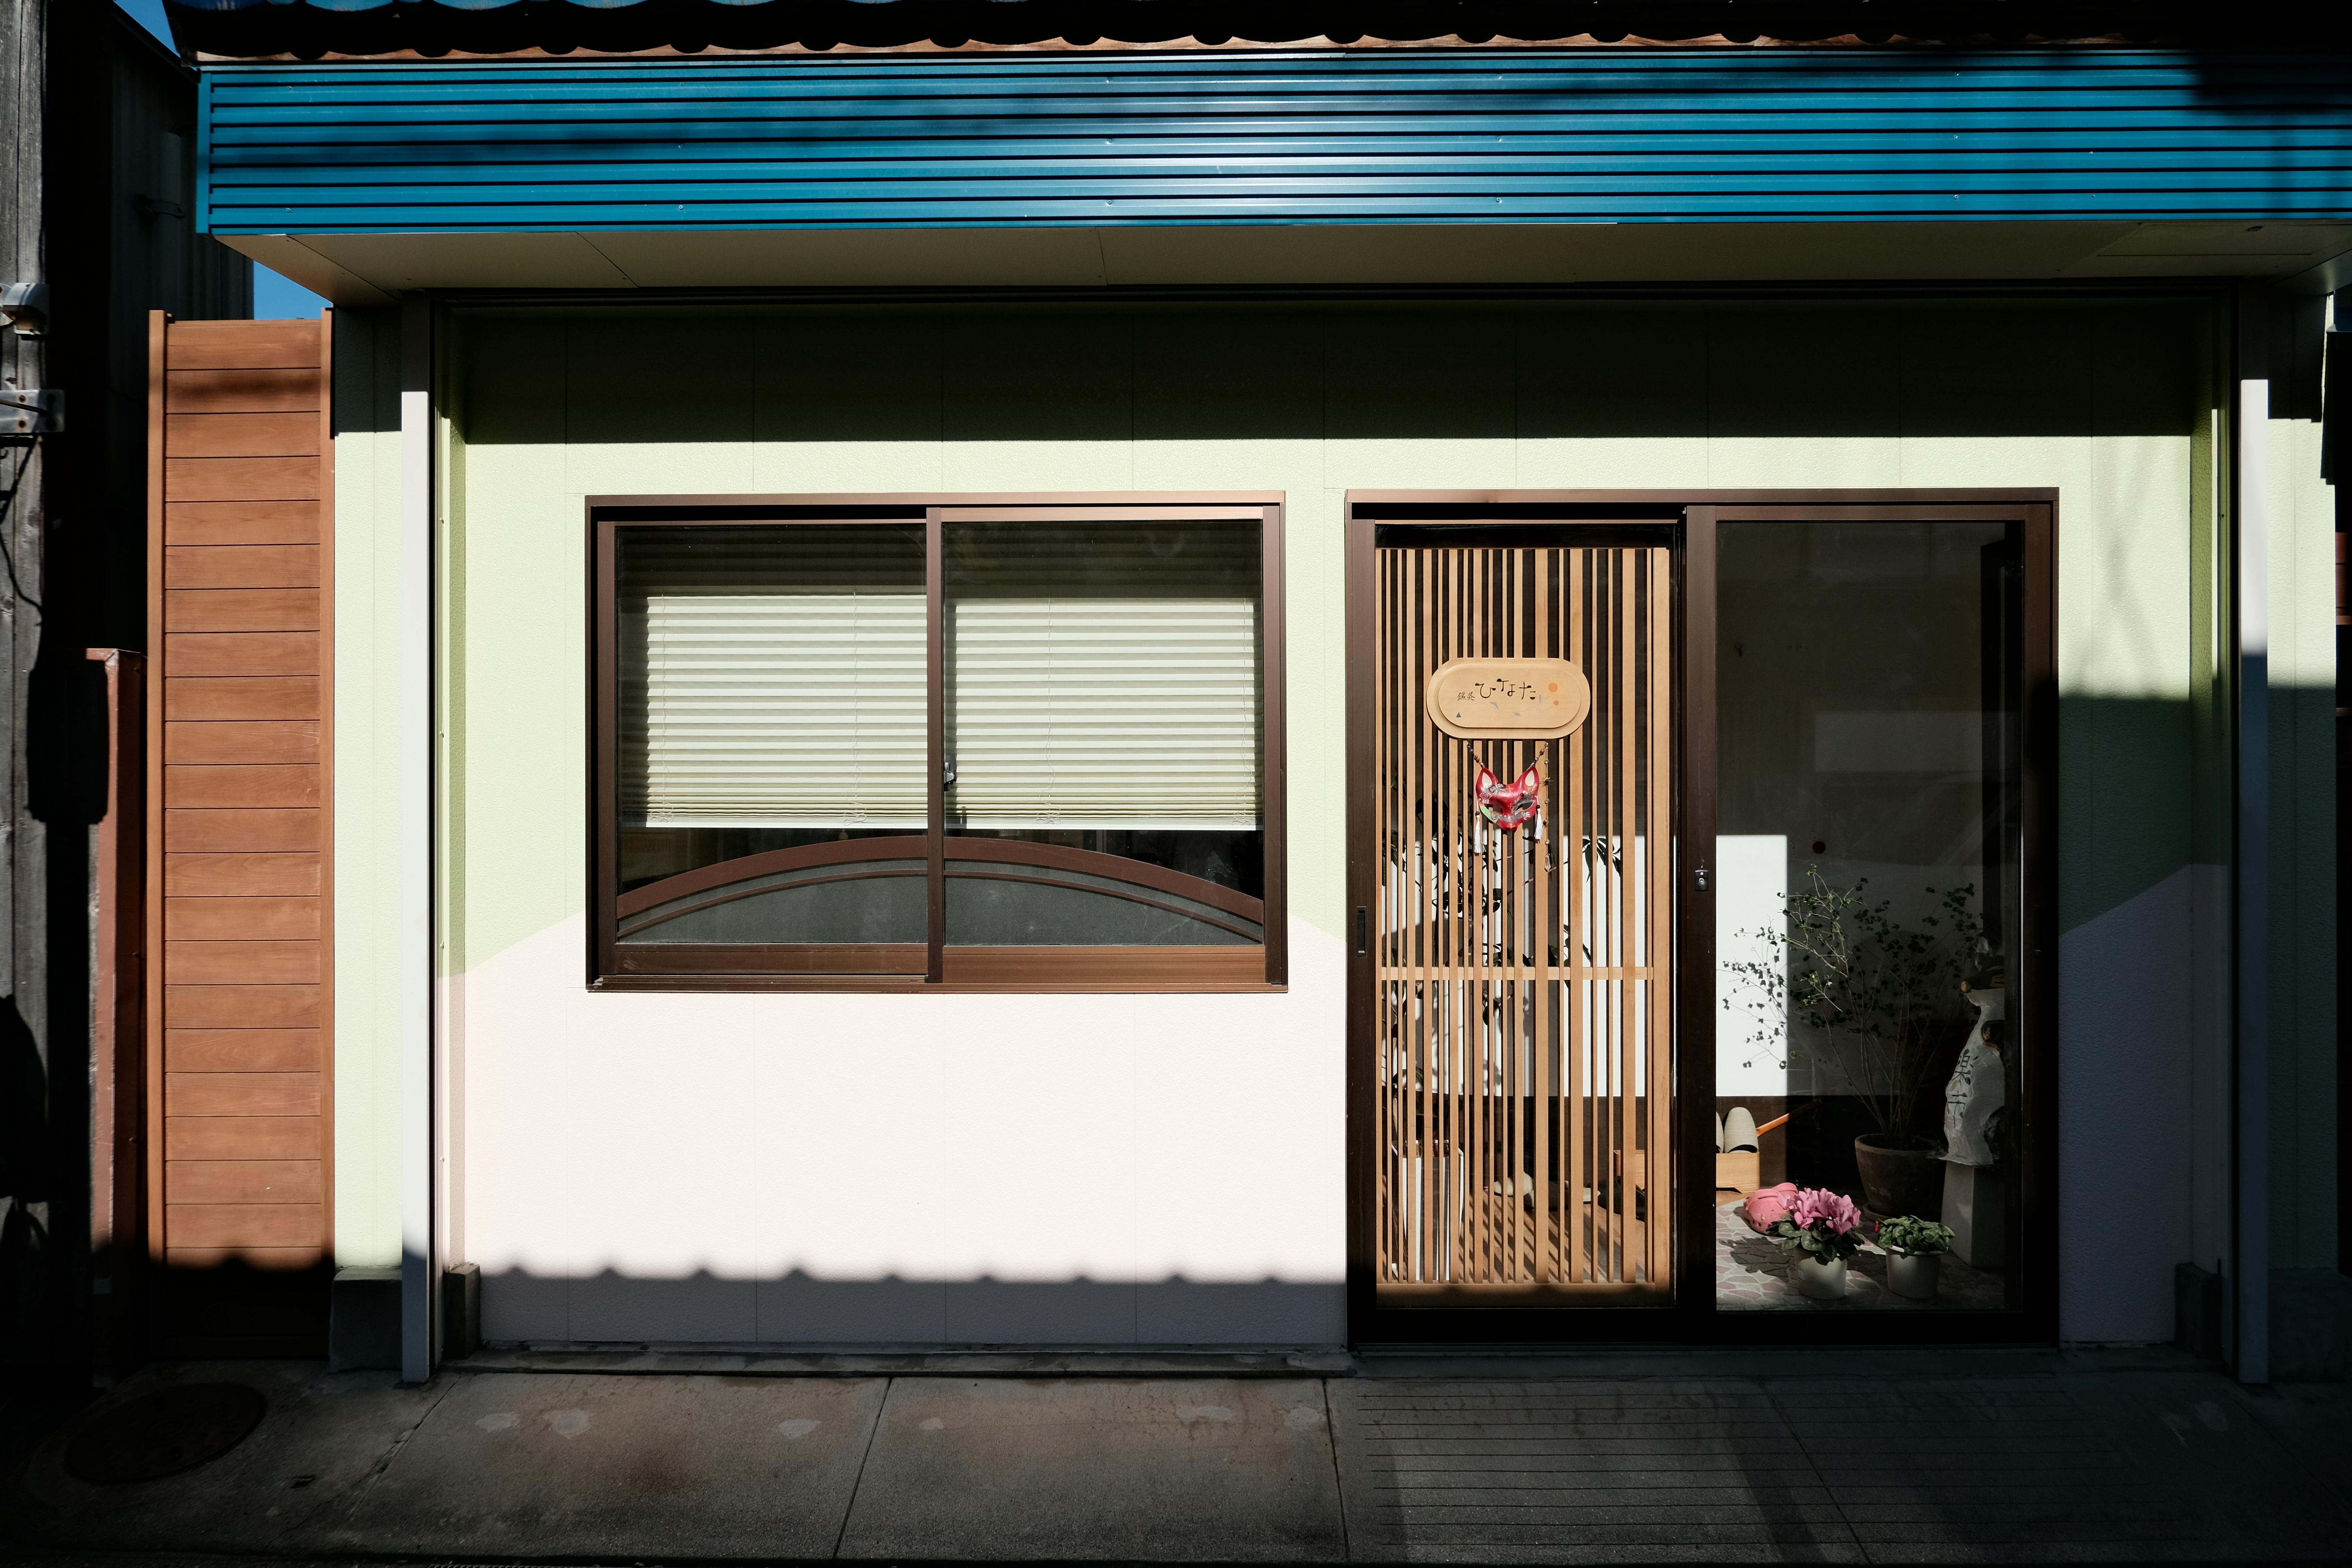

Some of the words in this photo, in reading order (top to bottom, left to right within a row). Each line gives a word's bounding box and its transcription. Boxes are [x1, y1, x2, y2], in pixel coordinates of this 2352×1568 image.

[1457, 692, 1475, 701] 鍼灸
[1475, 678, 1536, 700] ひなた
[1948, 1049, 1978, 1128] 楽市
